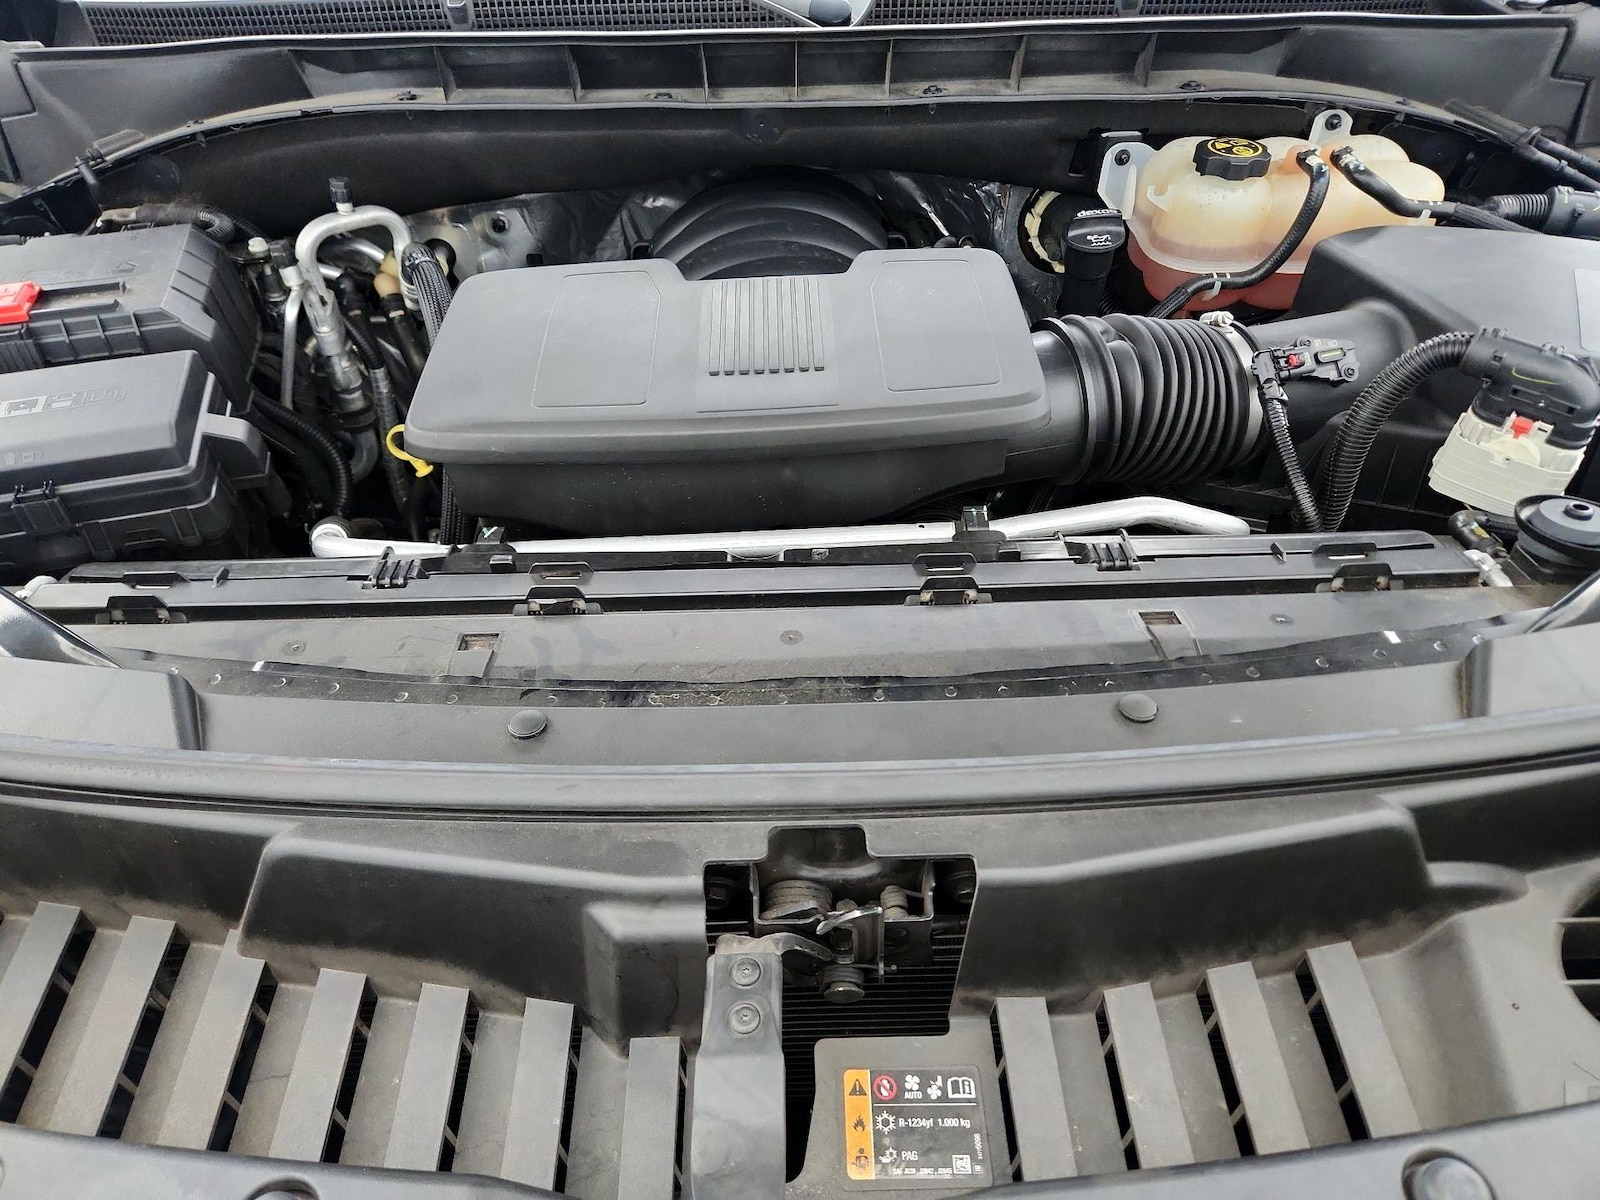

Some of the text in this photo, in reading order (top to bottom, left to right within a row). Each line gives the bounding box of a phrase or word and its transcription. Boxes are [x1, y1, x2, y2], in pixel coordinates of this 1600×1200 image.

[904, 1091, 922, 1099] AUTO
[899, 1118, 971, 1129] R-1234yf 1.000 kg
[901, 1150, 919, 1161] PAG
